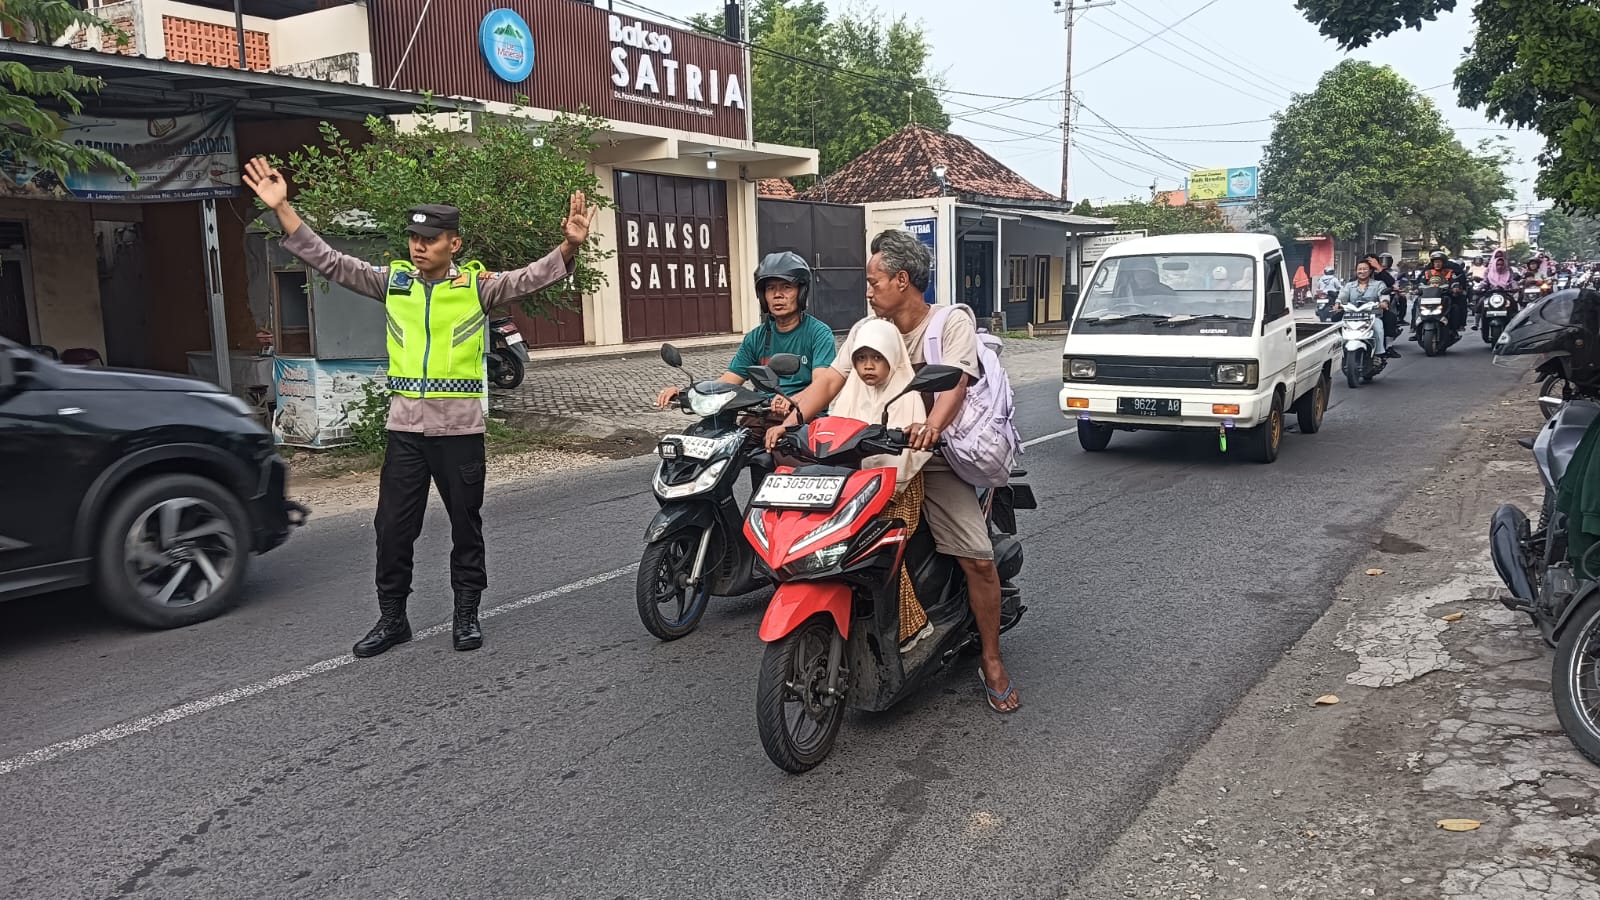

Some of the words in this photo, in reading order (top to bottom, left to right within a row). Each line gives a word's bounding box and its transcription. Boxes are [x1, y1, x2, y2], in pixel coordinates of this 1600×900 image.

[608, 14, 673, 55] Bakso
[610, 46, 745, 110] SATRIA
[627, 220, 710, 249] BAKSO
[630, 262, 728, 290] SATRIA
[1118, 397, 1124, 409] L
[1134, 398, 1157, 411] 9622
[765, 477, 782, 489] AG
[783, 477, 816, 489] 3050
[815, 478, 840, 490] VCS
